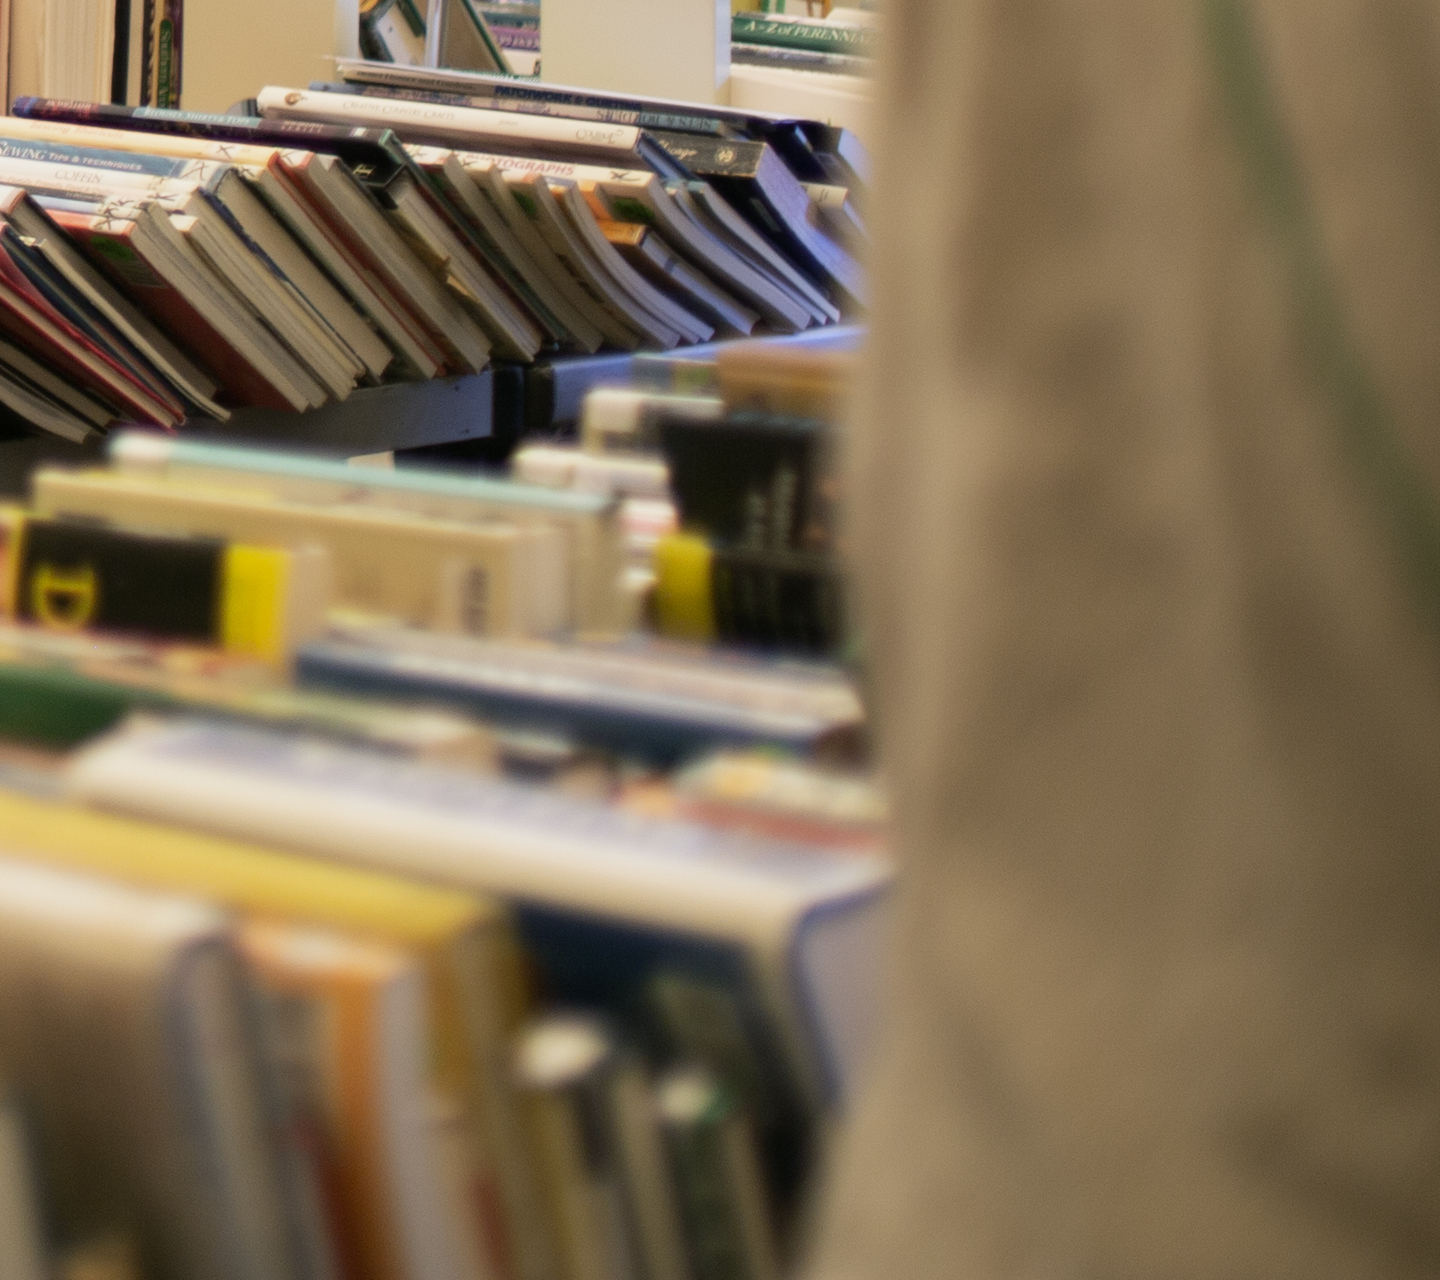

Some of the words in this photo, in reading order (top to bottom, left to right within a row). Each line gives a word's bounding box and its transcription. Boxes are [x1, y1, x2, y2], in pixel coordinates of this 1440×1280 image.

[495, 85, 572, 104] PATCHWORK
[49, 153, 68, 162] TIPS
[81, 158, 142, 171] TECHNIQUES
[55, 169, 104, 184] COFFIN
